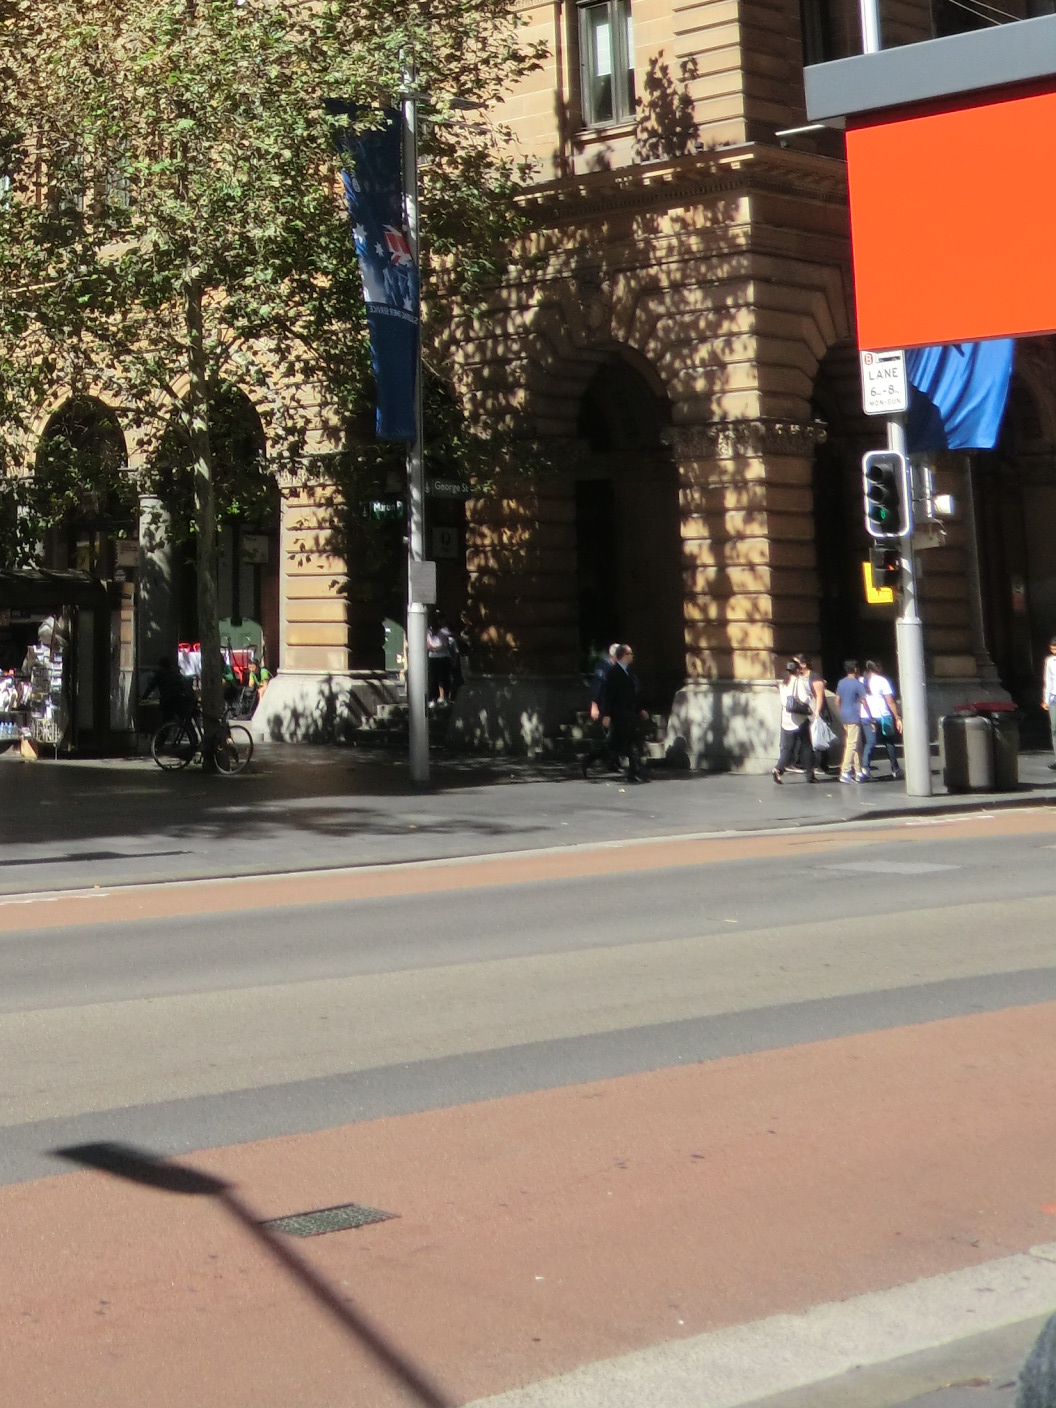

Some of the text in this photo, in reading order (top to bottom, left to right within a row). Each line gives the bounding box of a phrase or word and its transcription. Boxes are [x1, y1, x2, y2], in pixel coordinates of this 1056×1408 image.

[868, 367, 899, 381] LANE
[869, 397, 902, 407] MON-SUN
[434, 480, 469, 495] George St
